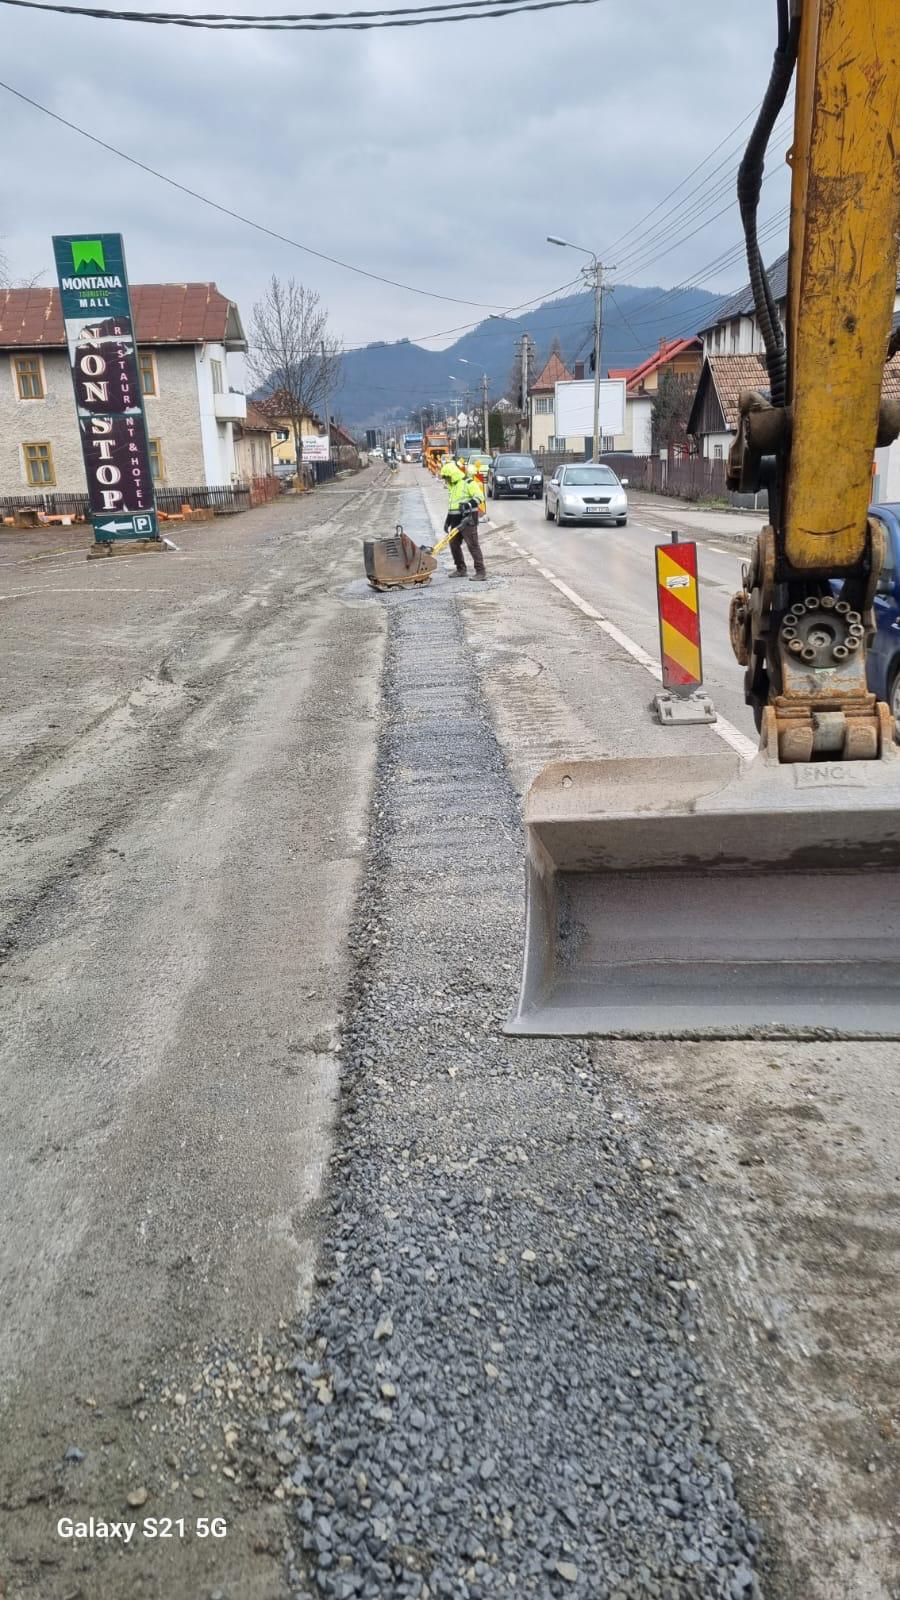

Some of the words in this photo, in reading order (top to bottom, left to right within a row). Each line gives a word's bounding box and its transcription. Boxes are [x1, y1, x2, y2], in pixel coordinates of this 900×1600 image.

[62, 275, 122, 290] MONTANA
[80, 290, 109, 298] TOURISTIC
[79, 298, 110, 308] MALL
[79, 327, 109, 402] NON
[128, 442, 138, 452] &
[91, 416, 123, 510] STOP
[131, 457, 144, 508] HOTEL
[136, 518, 148, 530] P
